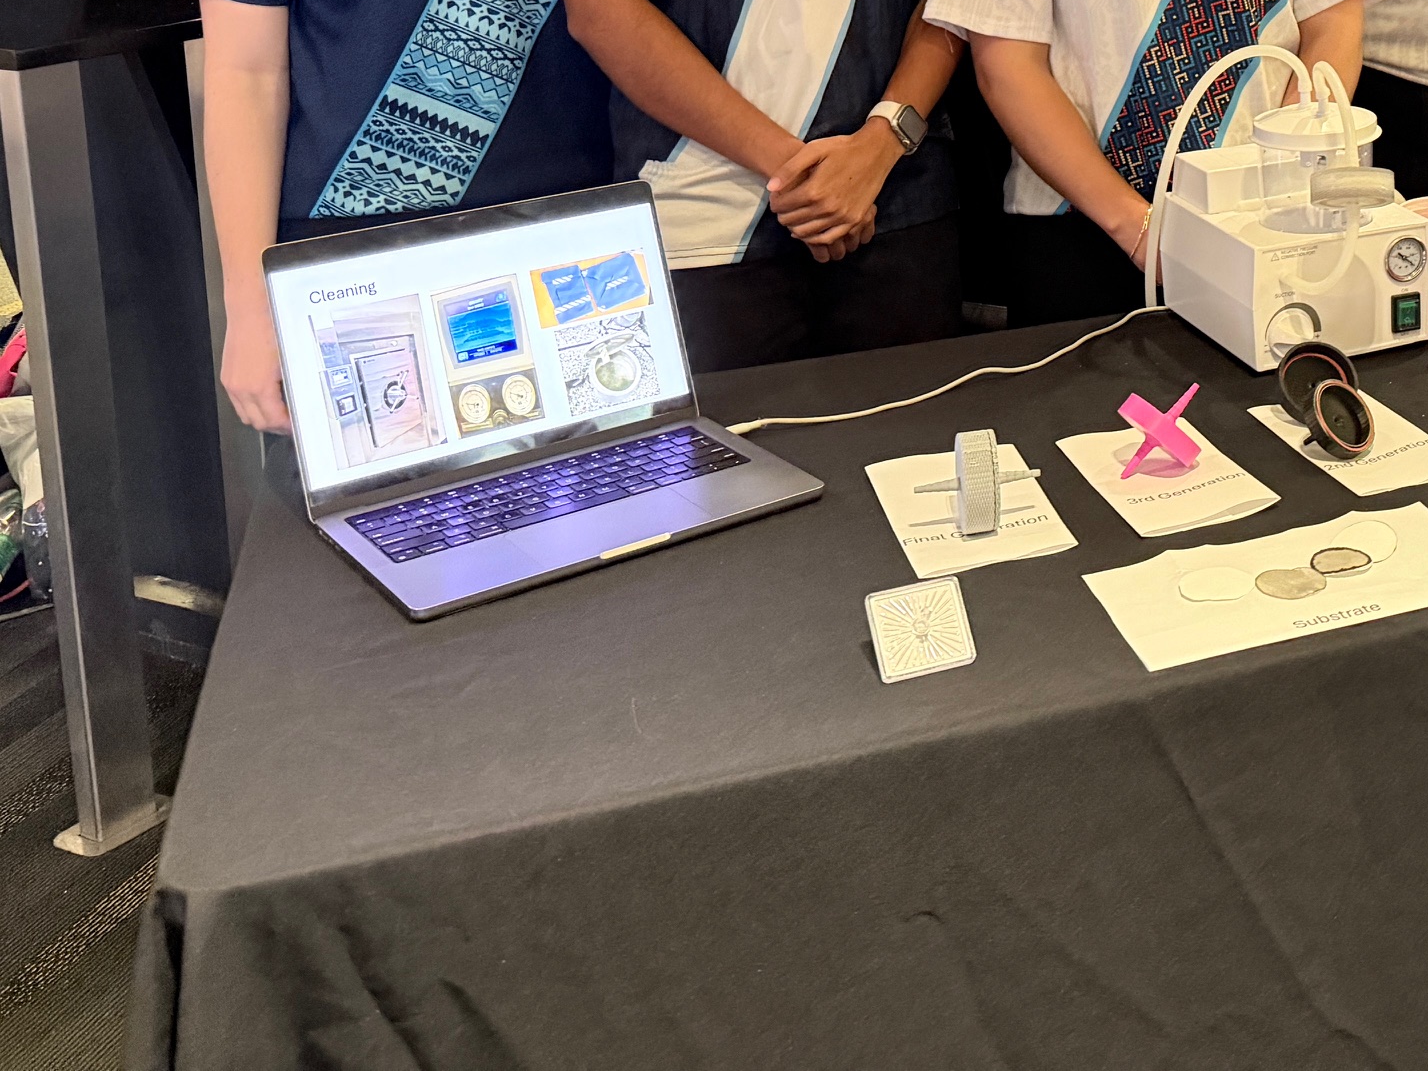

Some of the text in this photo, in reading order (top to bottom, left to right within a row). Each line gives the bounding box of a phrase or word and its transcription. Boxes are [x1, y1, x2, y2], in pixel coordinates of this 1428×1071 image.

[309, 281, 377, 304] Cleaning
[1324, 460, 1354, 471] 2nd
[1127, 472, 1246, 505] 3rd Generation
[903, 533, 947, 546] Final
[1293, 603, 1381, 629] Substrate
